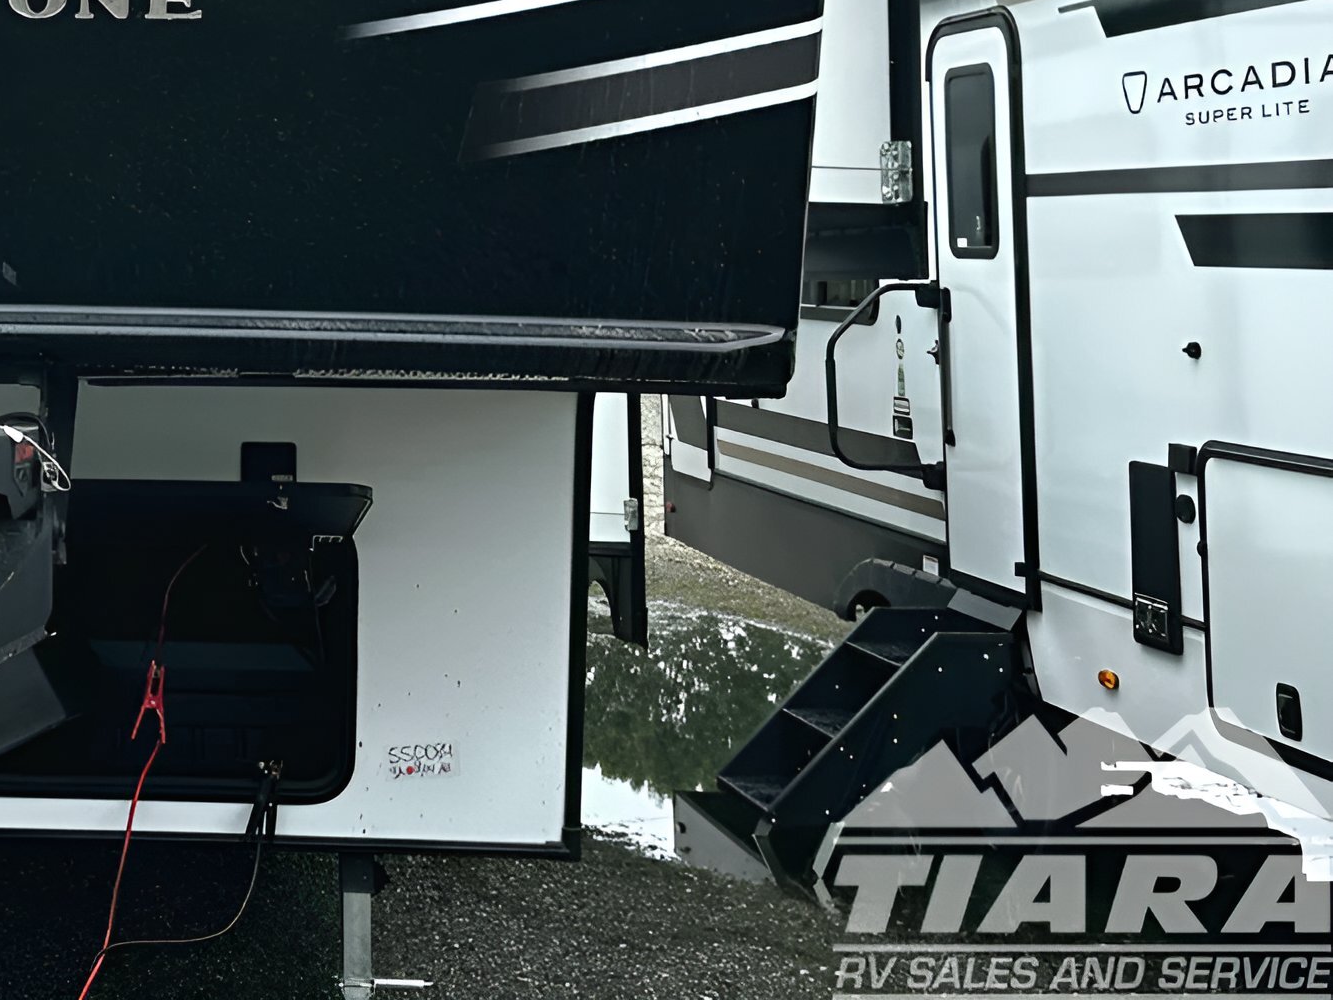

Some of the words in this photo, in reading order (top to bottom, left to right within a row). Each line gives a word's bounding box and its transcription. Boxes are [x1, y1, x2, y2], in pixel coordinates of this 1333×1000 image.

[1156, 53, 1333, 104] ARCADIA
[1185, 106, 1253, 126] SUPER
[1261, 99, 1310, 118] LITE
